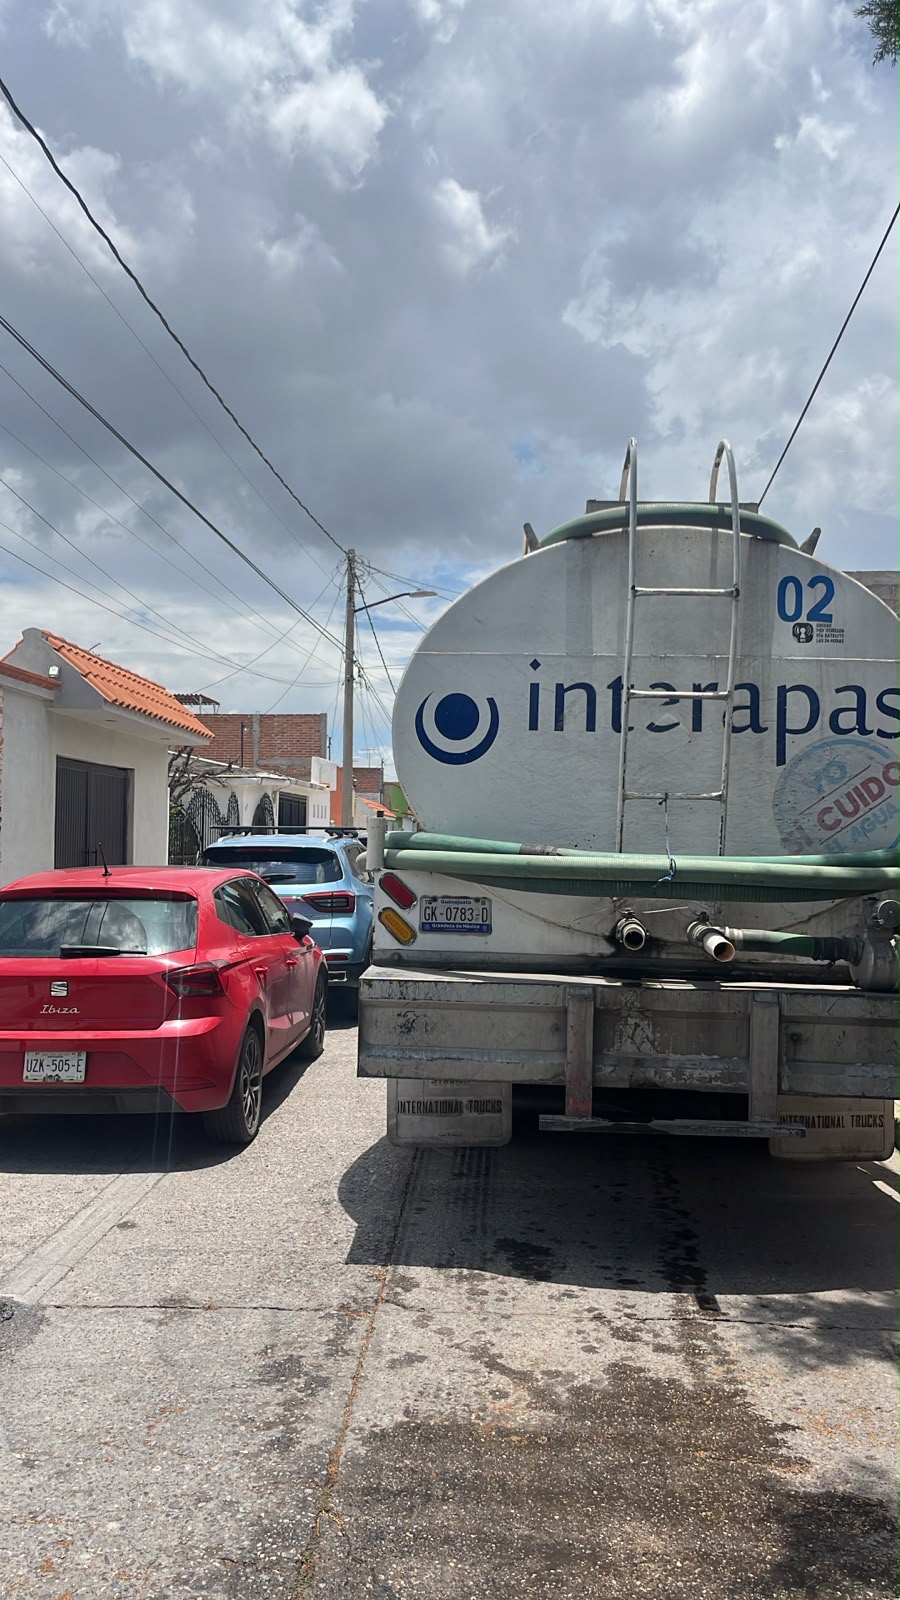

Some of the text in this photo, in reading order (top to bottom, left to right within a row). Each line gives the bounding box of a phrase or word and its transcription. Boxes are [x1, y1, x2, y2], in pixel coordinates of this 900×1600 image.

[777, 575, 834, 623] 02
[424, 906, 488, 922] GK-0783-D
[40, 1004, 80, 1014] Ibiza
[26, 1059, 83, 1073] UZK-505-E
[397, 1099, 502, 1115] INTERNATIONAL TRUCKS
[851, 1114, 884, 1128] TRUCKS
